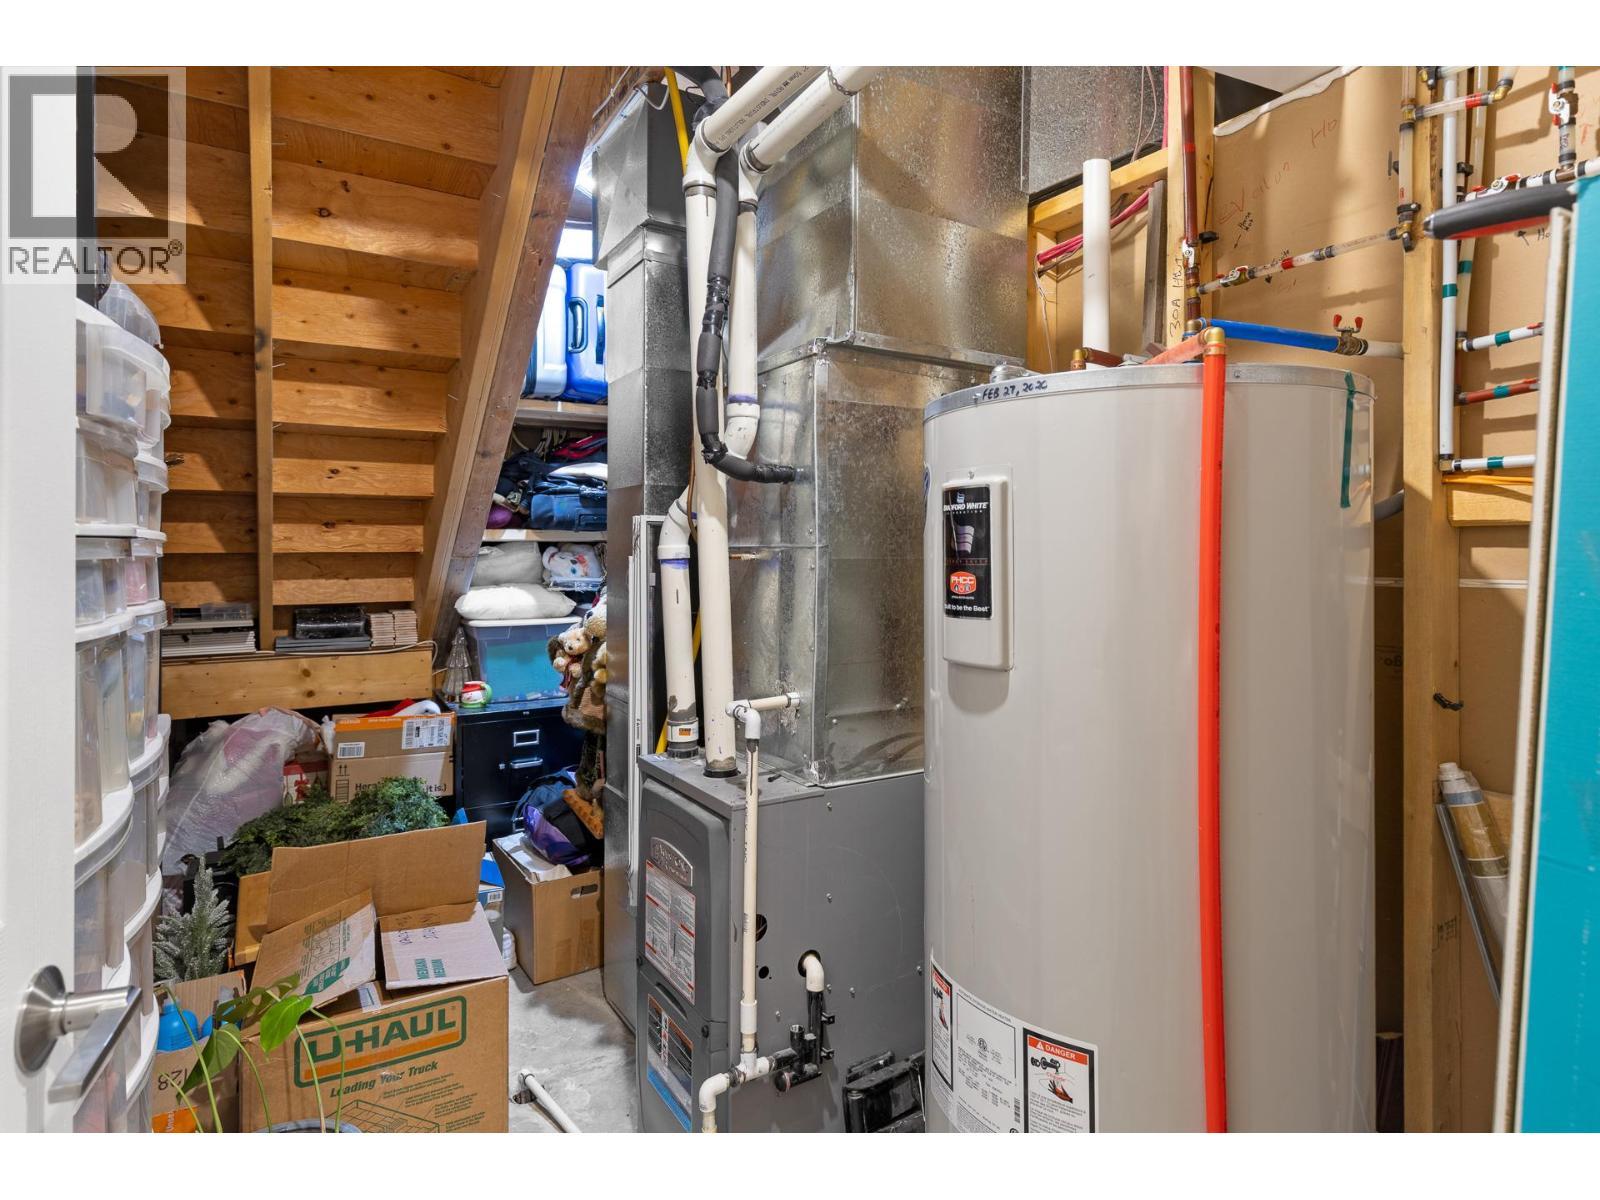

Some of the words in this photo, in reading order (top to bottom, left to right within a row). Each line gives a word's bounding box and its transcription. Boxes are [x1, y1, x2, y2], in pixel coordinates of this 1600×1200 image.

[982, 386, 1000, 400] FEB
[1045, 1045, 1076, 1060] DANGER
[329, 1077, 376, 1099] Loading
[408, 1060, 438, 1078] Truck
